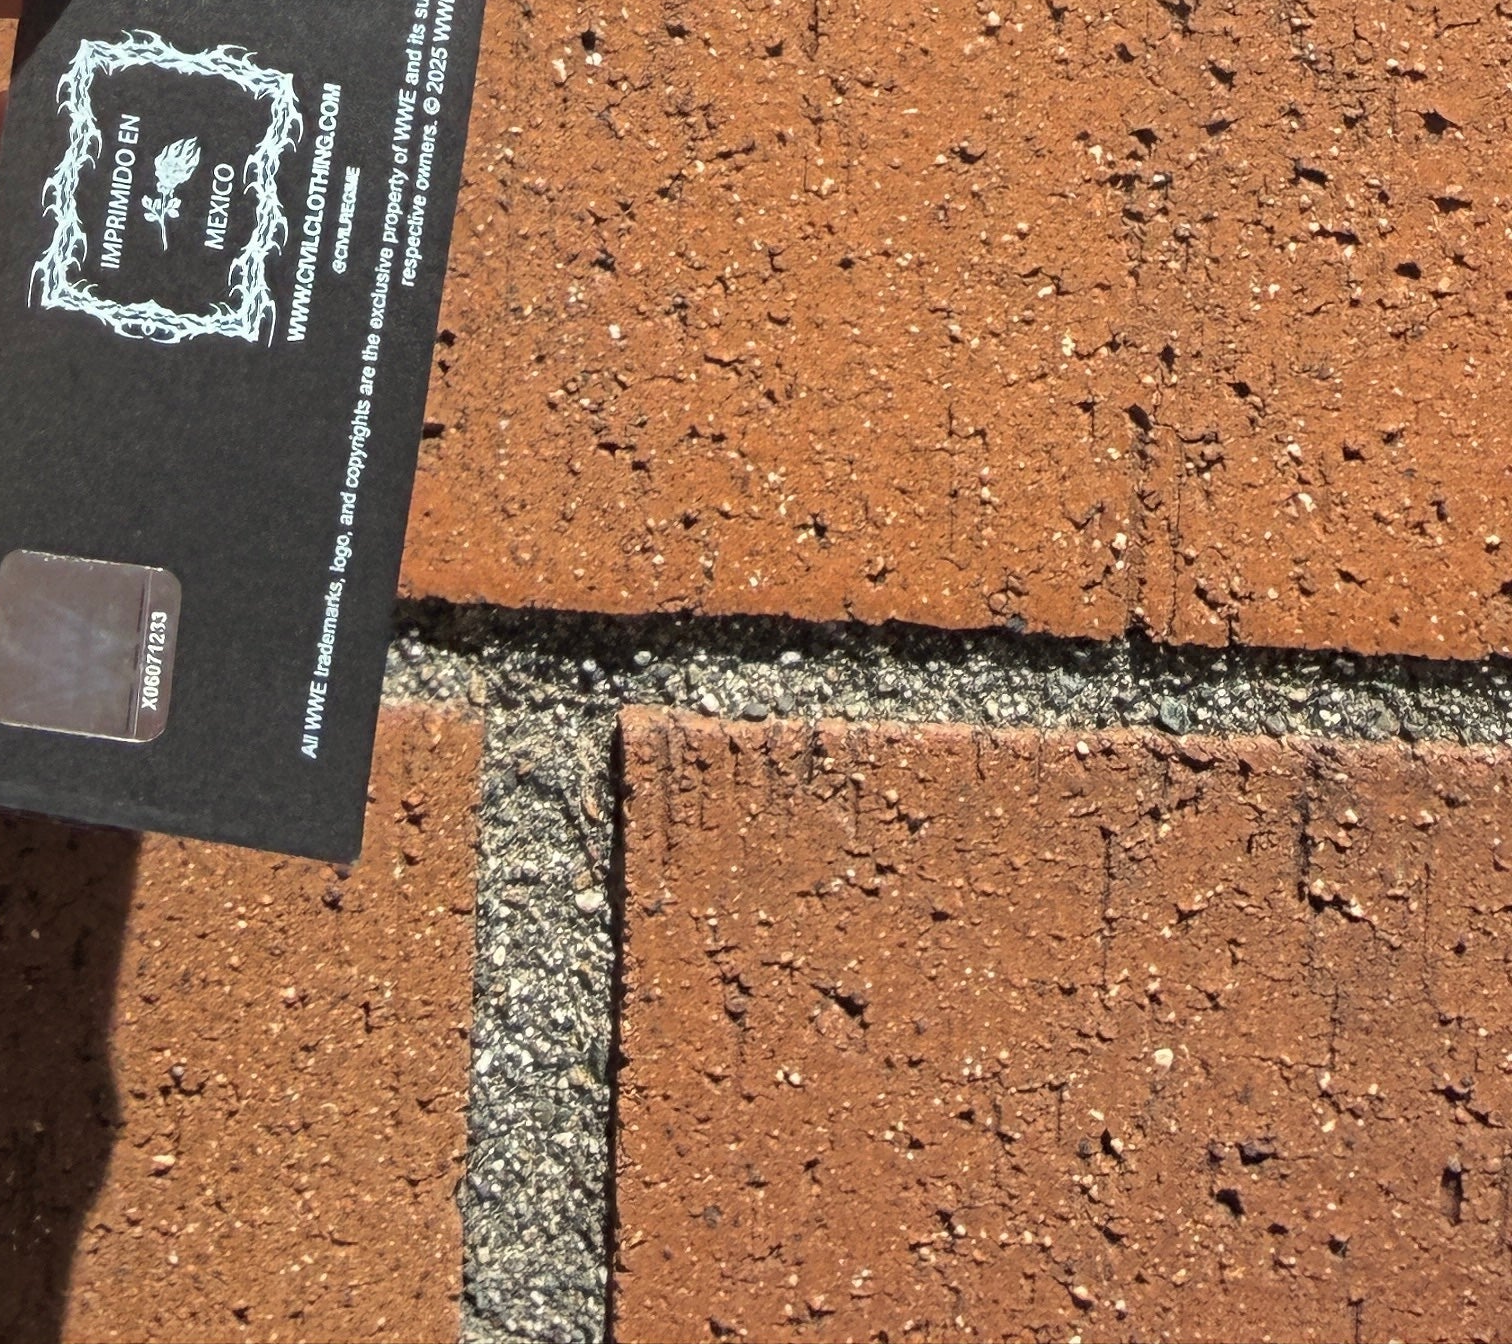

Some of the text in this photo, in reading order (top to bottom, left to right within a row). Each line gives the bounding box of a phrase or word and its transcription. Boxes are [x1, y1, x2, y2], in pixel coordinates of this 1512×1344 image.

[406, 23, 427, 46] its
[405, 48, 423, 86] and
[425, 46, 448, 95] 2025
[393, 88, 417, 141] WWE
[391, 143, 408, 165] of
[415, 120, 438, 191] owners.
[100, 113, 141, 269] IMPRIMIDO EN
[203, 163, 235, 250] MEXICO
[286, 82, 342, 342] WWW.CIVILCLOTHING.COM
[382, 167, 408, 244] property
[401, 194, 427, 287] respective
[369, 247, 394, 330] exclusive
[361, 333, 381, 362] the
[359, 365, 376, 396] are
[345, 399, 371, 488] copyrights
[339, 491, 357, 526] and
[329, 531, 353, 573] logo,
[313, 578, 346, 677] trademarks,
[140, 611, 168, 711] X06071233
[304, 680, 328, 730] WWE
[301, 733, 319, 759] All
